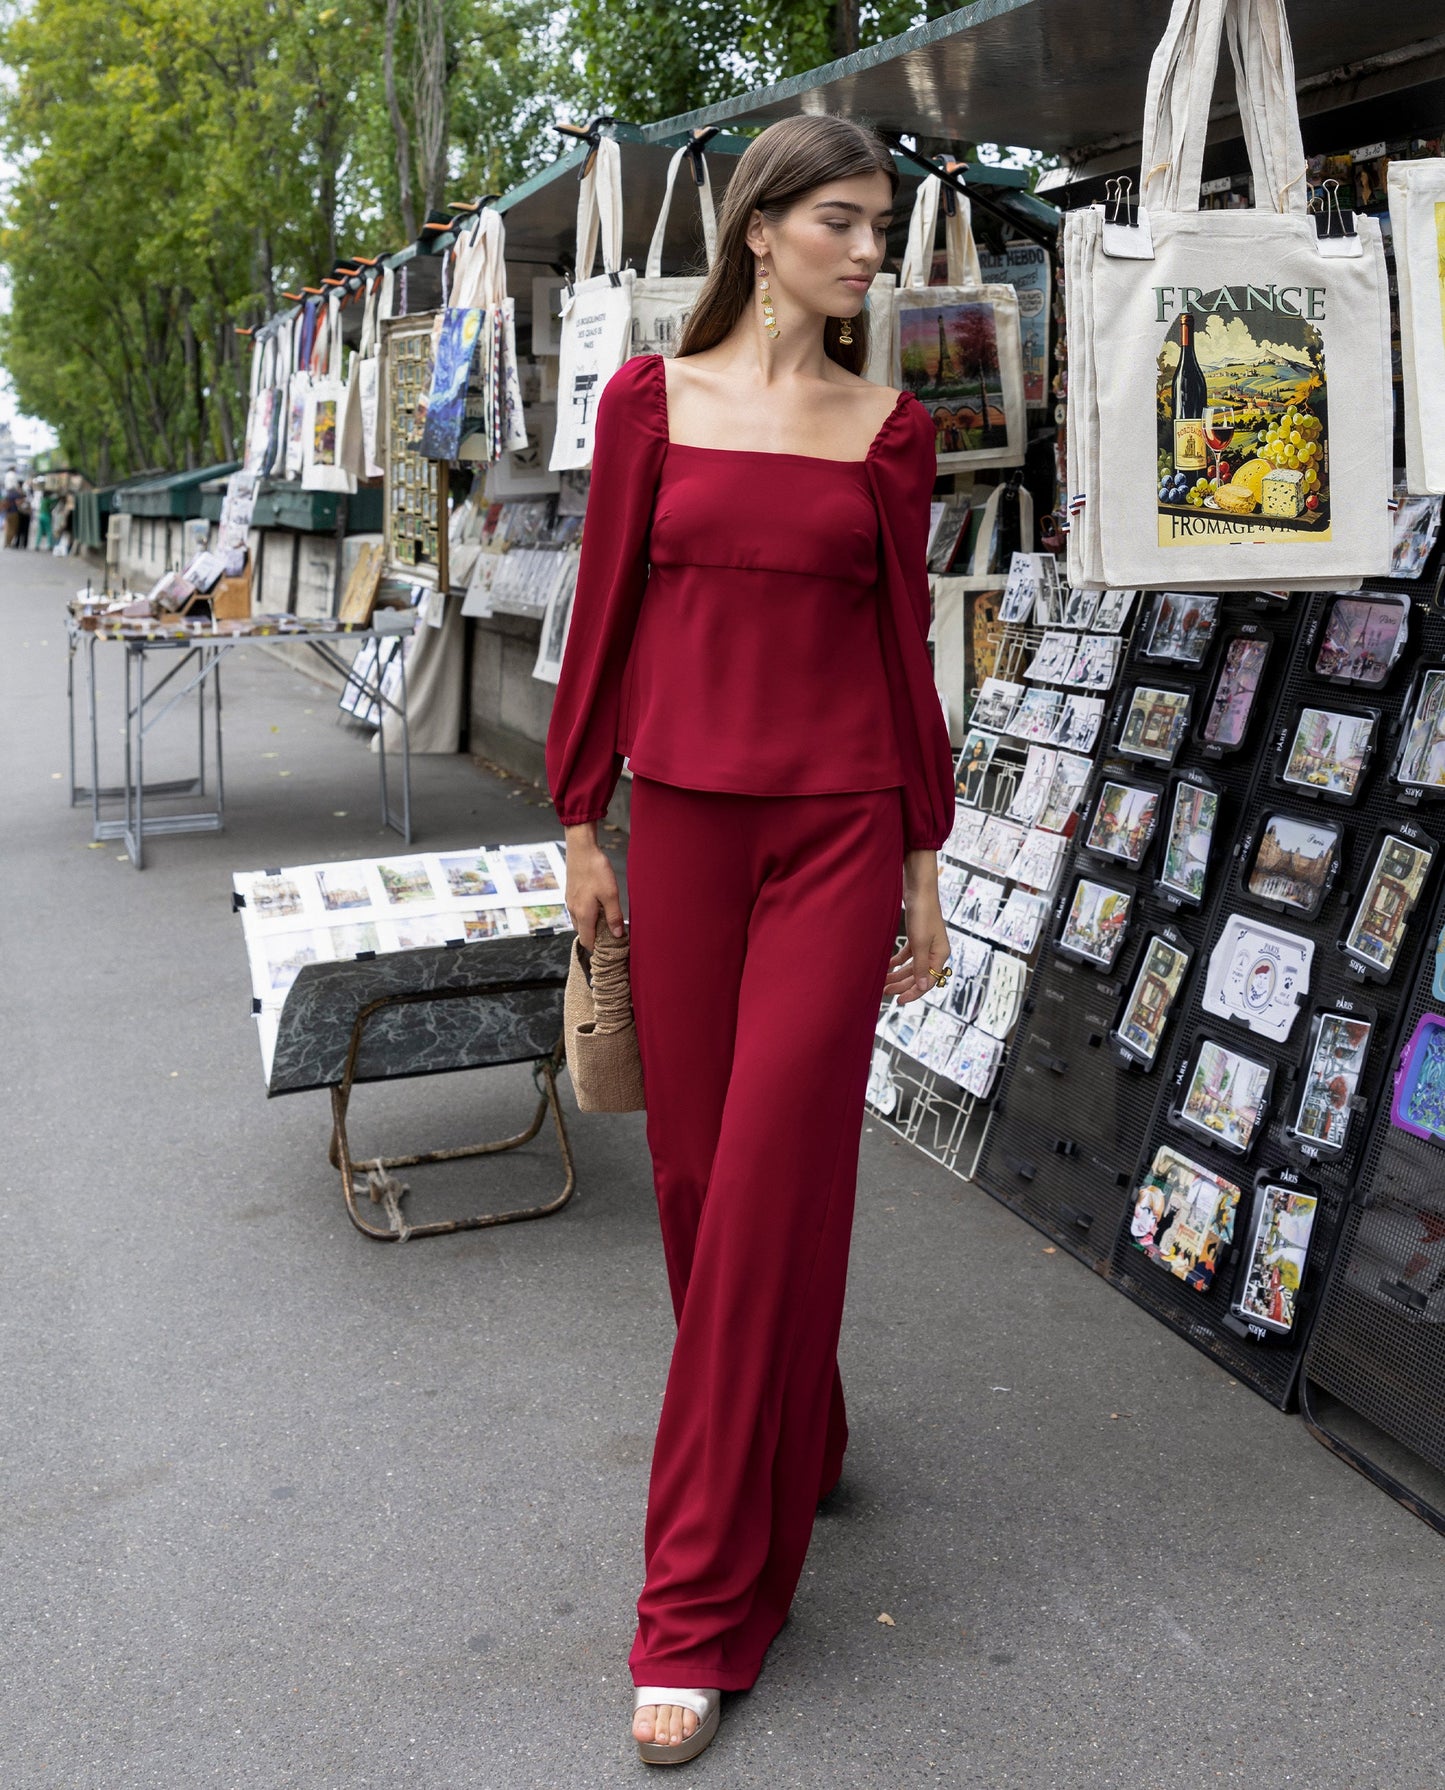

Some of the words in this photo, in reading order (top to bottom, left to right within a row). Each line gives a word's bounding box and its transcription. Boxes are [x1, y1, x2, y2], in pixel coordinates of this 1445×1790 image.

[979, 253, 1003, 268] RLIE
[1007, 248, 1045, 266] HEBDO
[1152, 284, 1327, 323] FRANCE
[1172, 515, 1255, 539] FROMAGE
[1400, 822, 1417, 838] PARIS
[1349, 959, 1366, 974] PARIS
[1336, 996, 1354, 1011] PARIS
[1176, 1060, 1189, 1085] PARIS
[1301, 1144, 1319, 1158] PARIS
[1280, 1168, 1298, 1184] PARIS
[1248, 1324, 1266, 1341] PARIS
